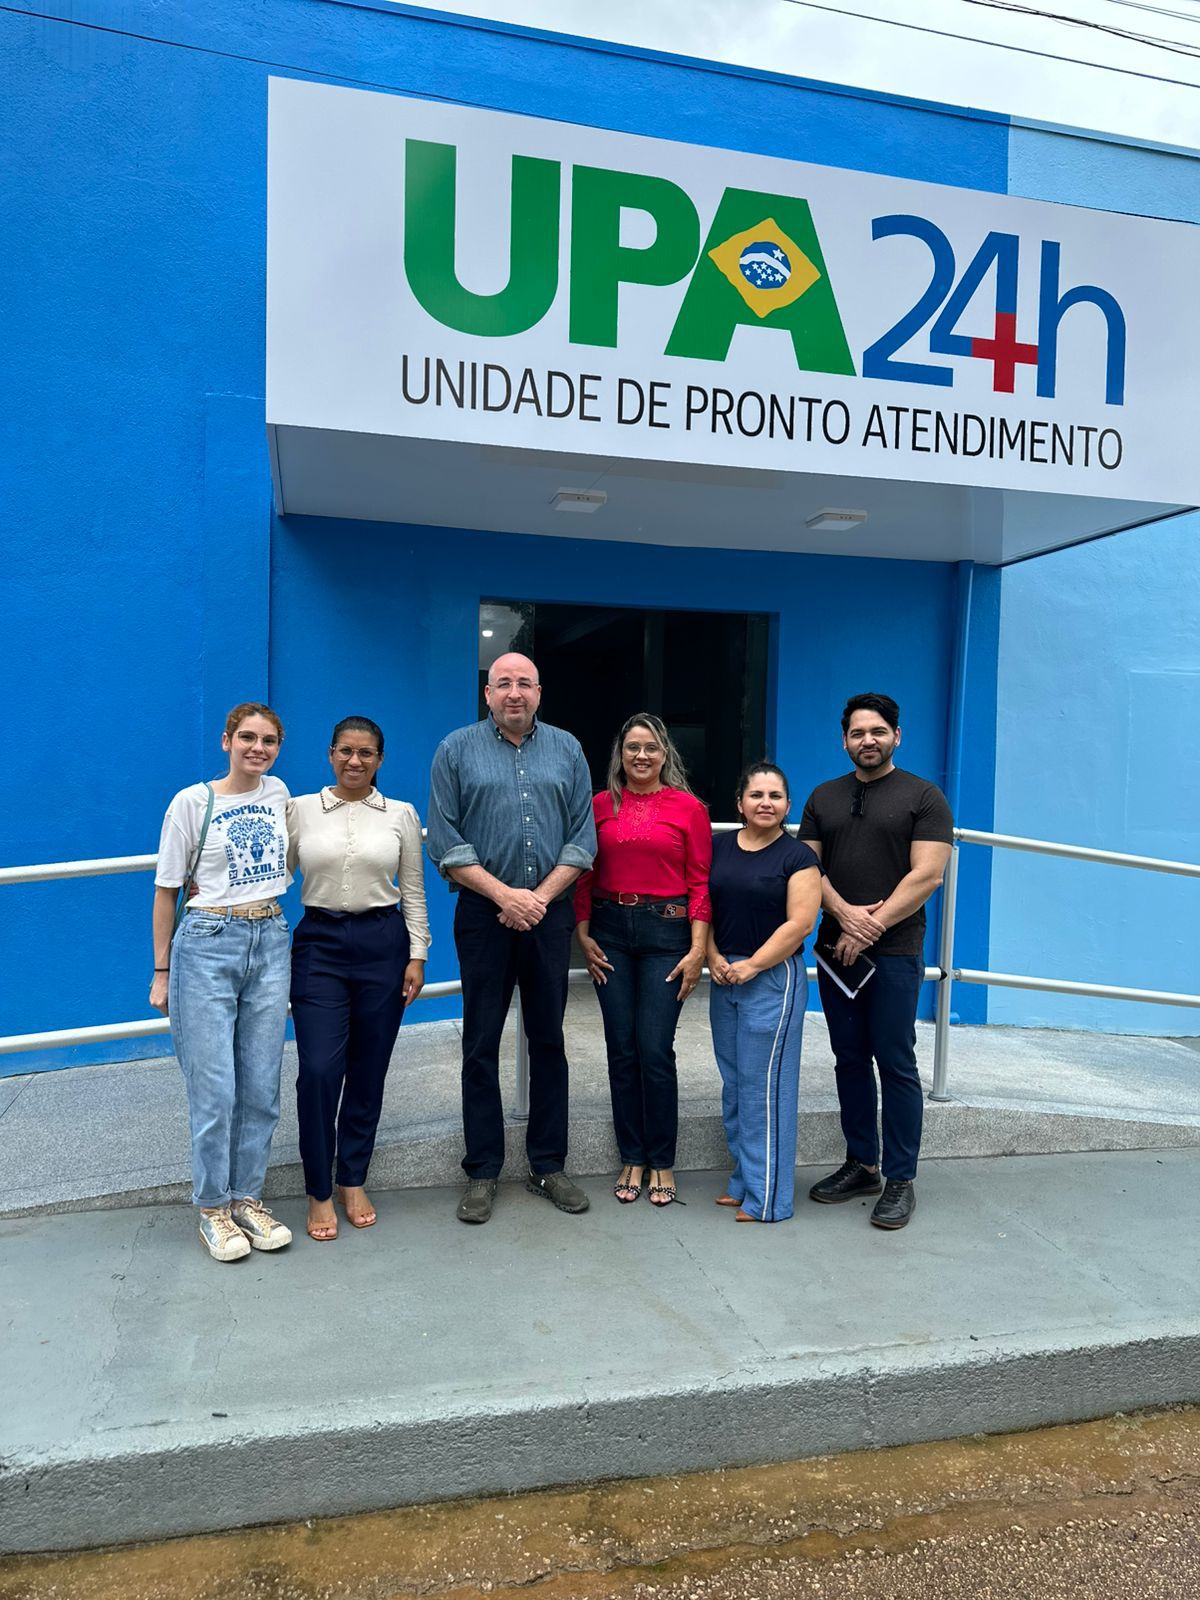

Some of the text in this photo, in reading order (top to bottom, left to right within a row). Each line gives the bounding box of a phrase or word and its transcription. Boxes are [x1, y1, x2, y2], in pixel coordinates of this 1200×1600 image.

[404, 139, 1127, 406] UPA 24h
[401, 355, 1123, 470] UNIDADE DE PRONTO ATENDIMENTO
[211, 804, 275, 825] TROPICAL
[243, 863, 275, 877] AZUL
